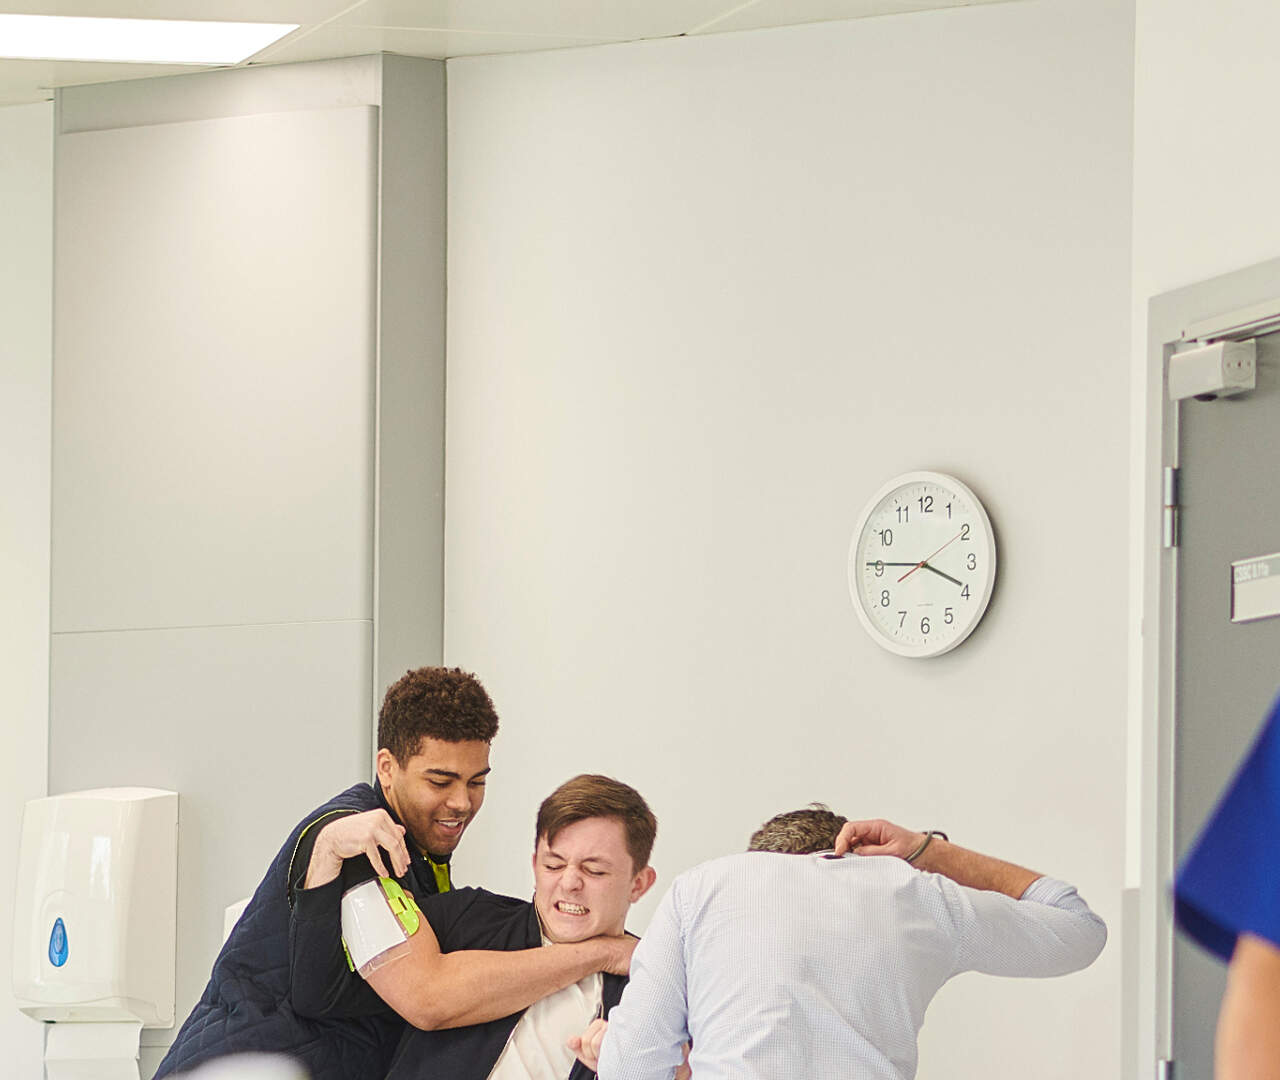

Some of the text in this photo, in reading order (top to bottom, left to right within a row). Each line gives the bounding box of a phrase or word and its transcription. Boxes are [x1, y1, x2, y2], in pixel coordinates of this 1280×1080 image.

[918, 496, 934, 513] 12
[945, 502, 952, 519] 1
[896, 506, 909, 523] 11
[879, 529, 893, 546] 10
[960, 524, 970, 540] 2
[874, 560, 884, 577] 9
[966, 553, 977, 570] 3
[880, 590, 890, 607] 8
[960, 584, 970, 600] 4
[898, 611, 907, 628] 7
[944, 608, 954, 624] 5
[920, 617, 930, 634] 6
